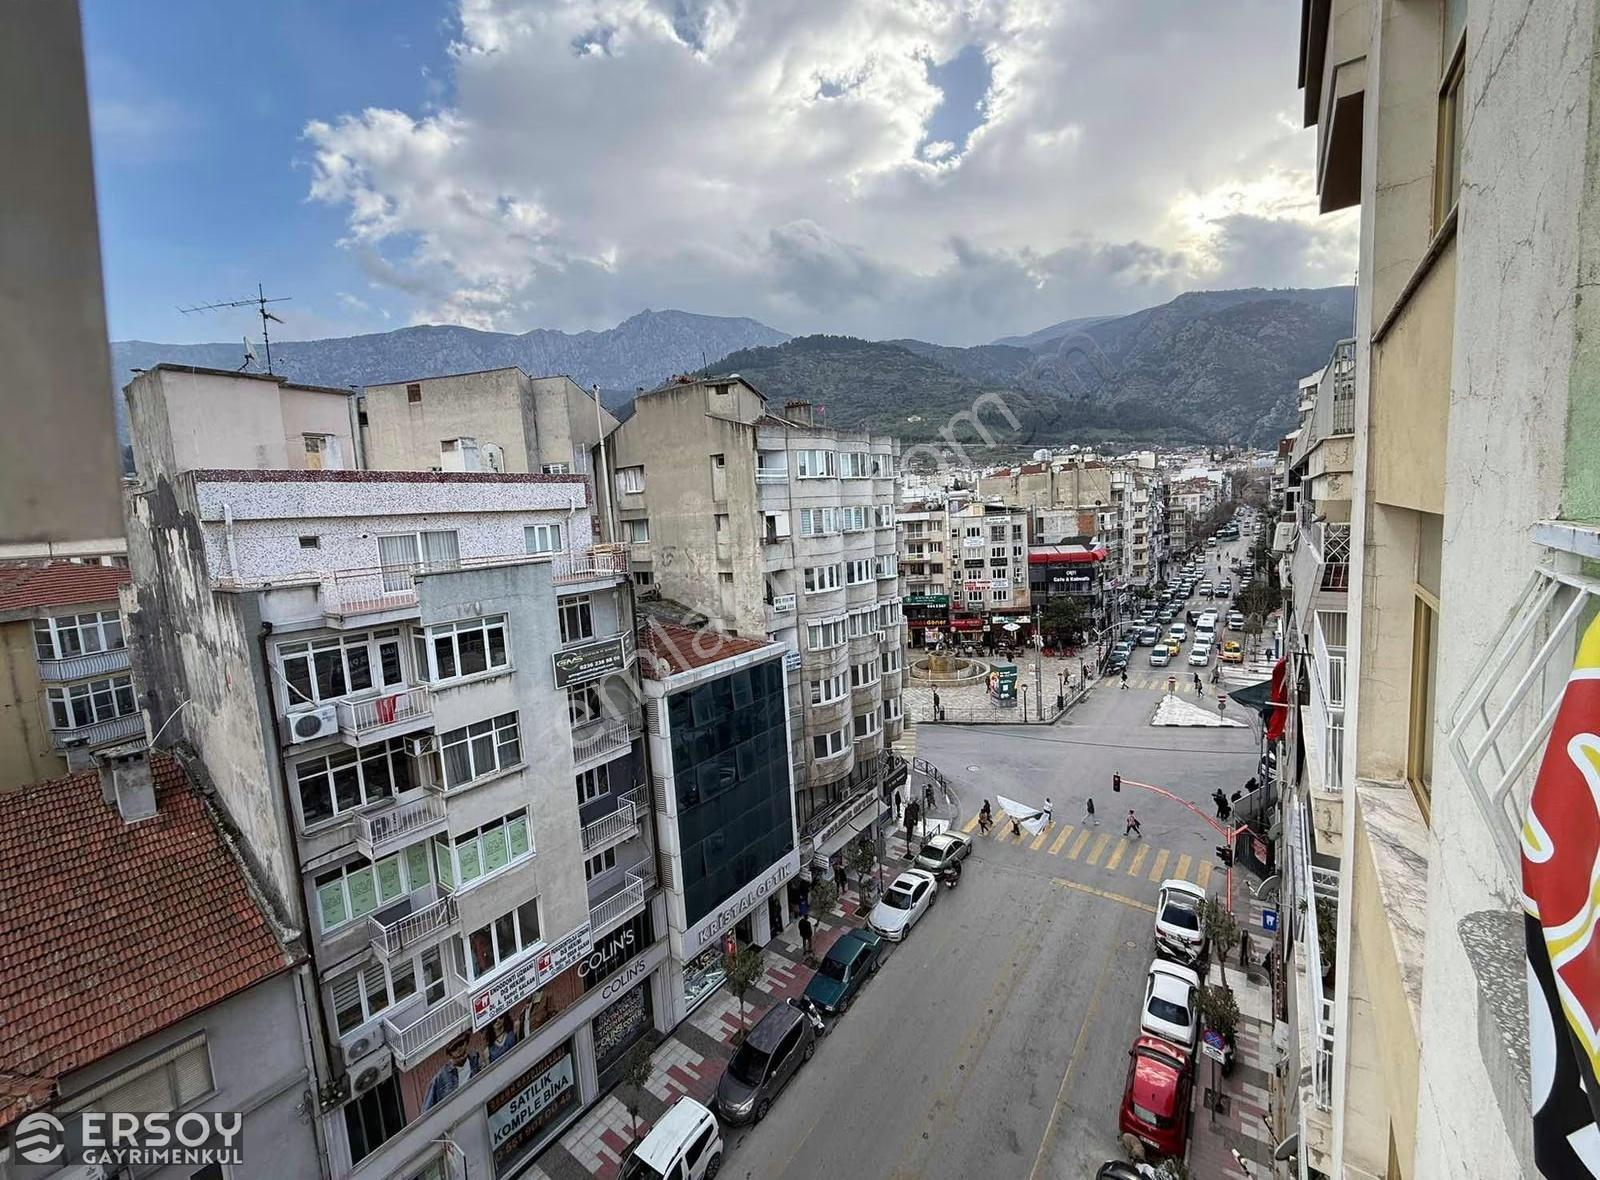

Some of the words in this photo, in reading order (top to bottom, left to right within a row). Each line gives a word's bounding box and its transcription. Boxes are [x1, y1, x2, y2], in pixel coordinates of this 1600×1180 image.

[698, 891, 756, 945] KRİSTAL
[755, 862, 792, 897] OPTİK
[577, 929, 635, 978] COLIN'S
[601, 960, 646, 1000] COLIN'S
[493, 1096, 543, 1145] KOMPLE
[543, 1074, 569, 1103] BİNA
[509, 1071, 553, 1114] SATILIK
